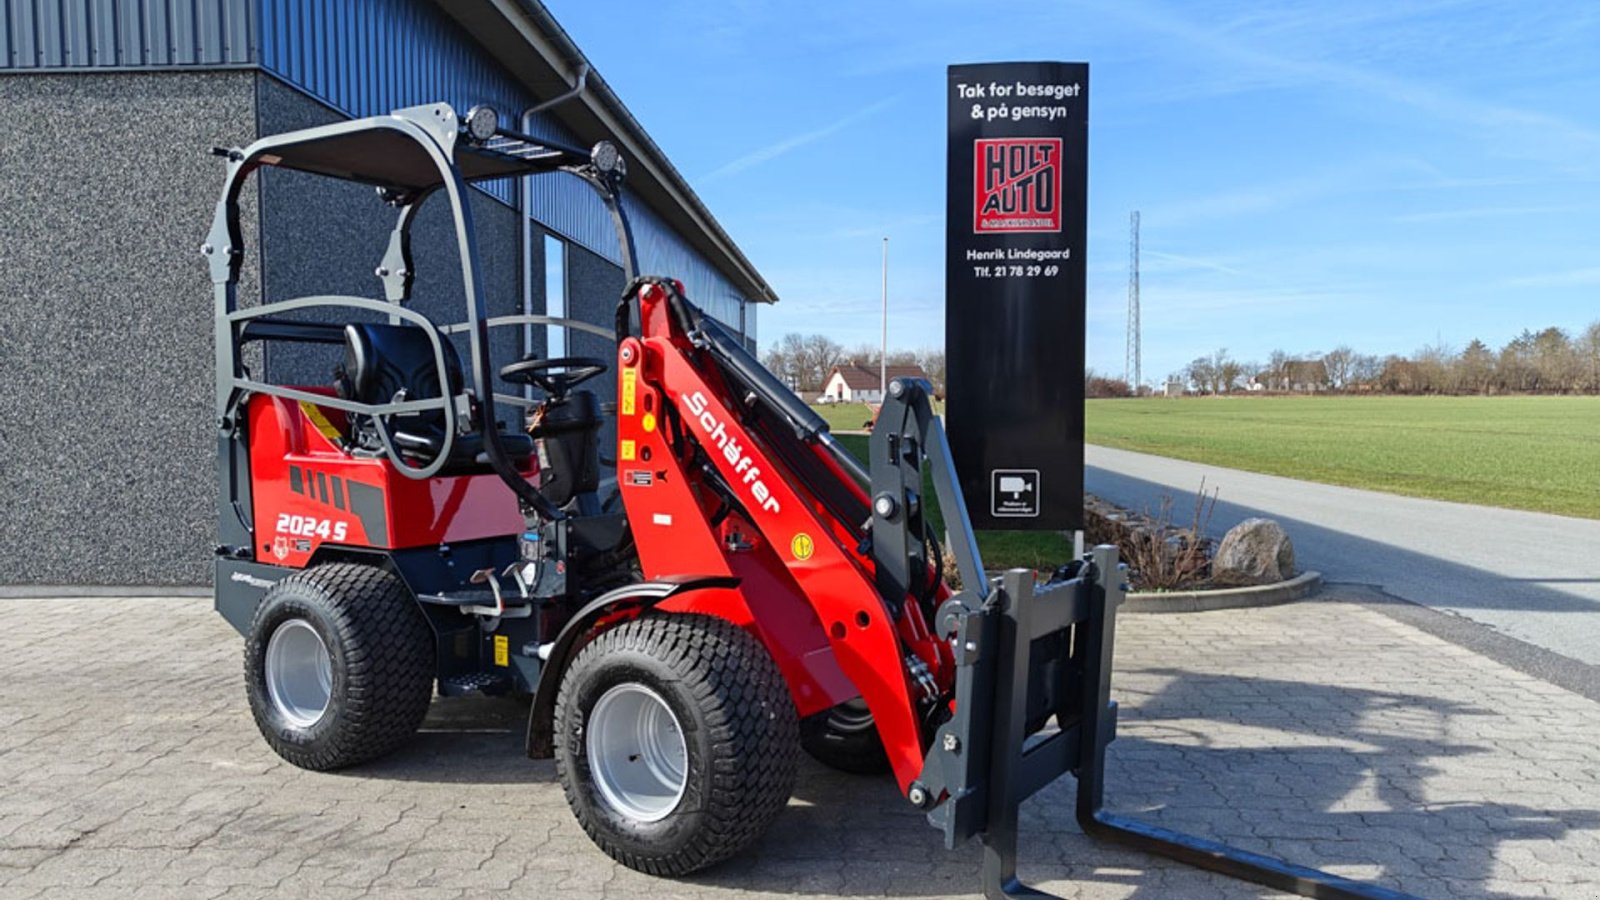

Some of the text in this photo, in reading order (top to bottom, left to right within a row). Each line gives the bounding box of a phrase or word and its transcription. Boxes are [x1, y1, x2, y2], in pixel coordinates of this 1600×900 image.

[957, 82, 1081, 100] Tak for besøget
[971, 103, 1067, 122] & på gensyn
[984, 143, 1056, 193] HOLT
[981, 165, 1056, 215] AUTO
[966, 248, 1070, 262] Henrik Lindegaard
[994, 266, 1007, 278] 21
[1009, 266, 1024, 277] 78
[1026, 266, 1041, 277] 29
[1043, 265, 1059, 277] 69
[681, 391, 781, 515] Schäffer
[276, 513, 348, 542] 2024 S
